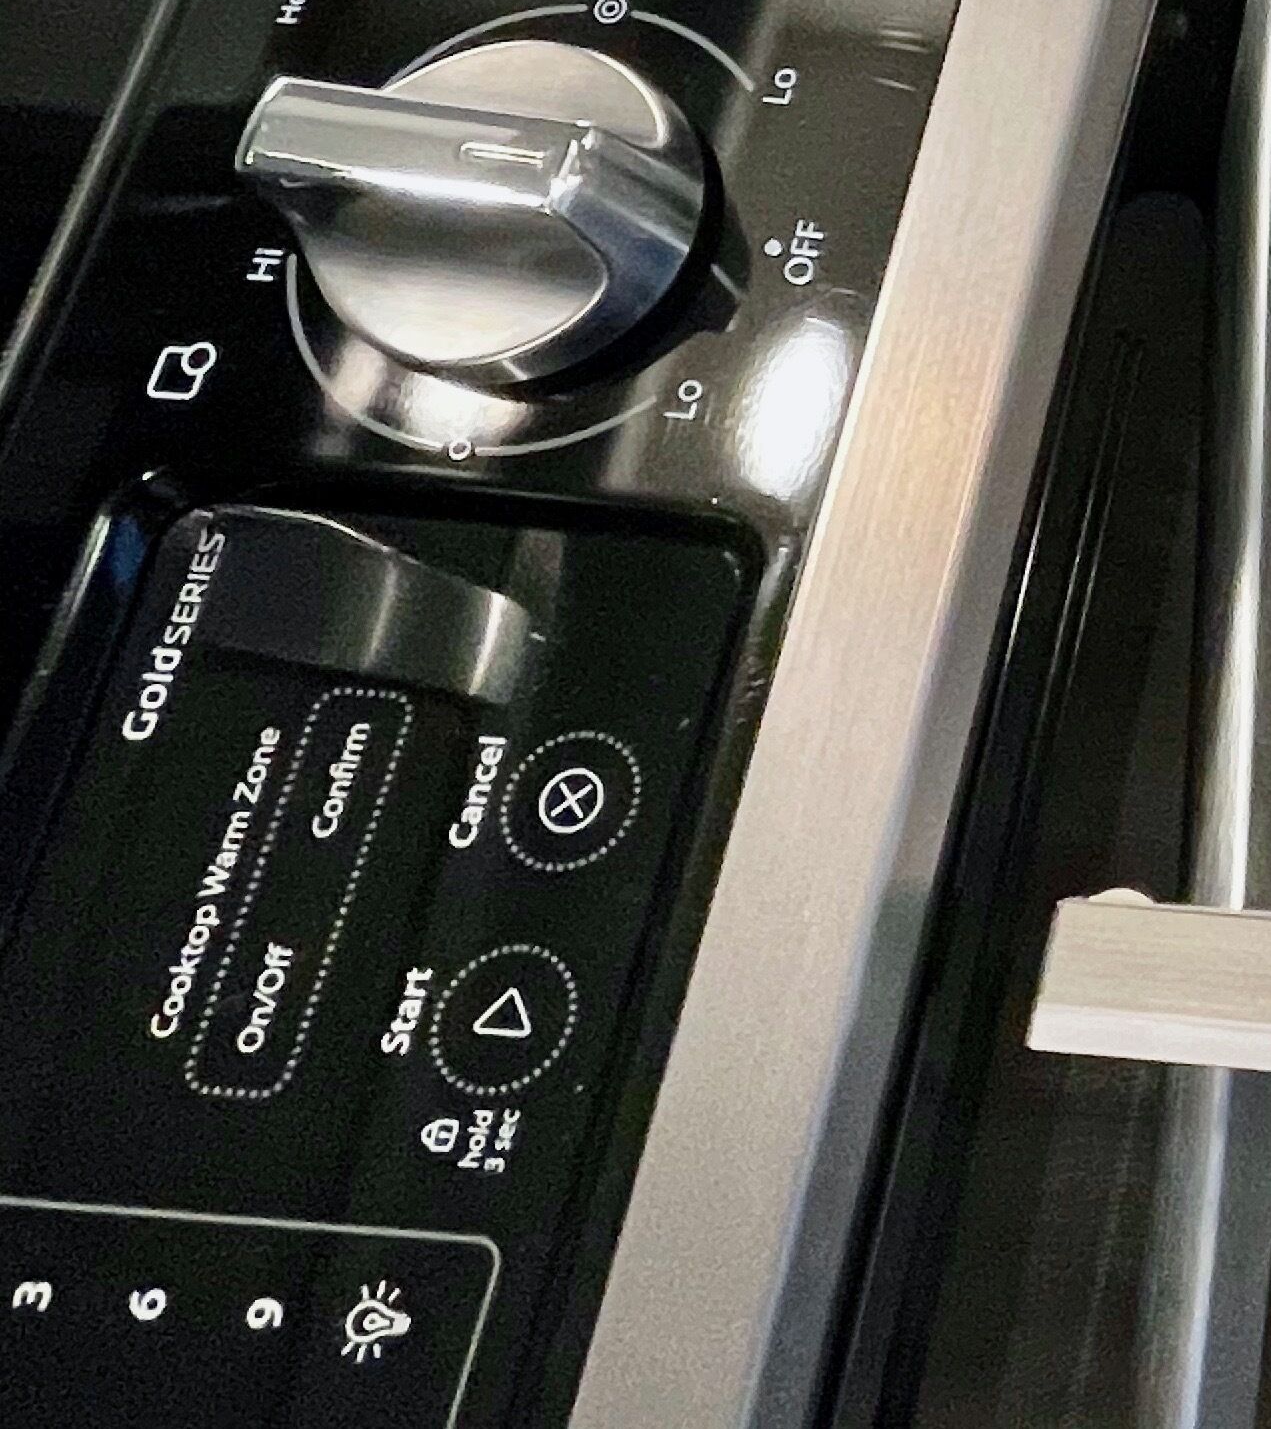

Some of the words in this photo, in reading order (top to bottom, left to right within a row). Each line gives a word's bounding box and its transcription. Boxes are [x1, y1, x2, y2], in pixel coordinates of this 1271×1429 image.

[762, 67, 797, 105] Lo
[246, 247, 285, 282] Hi
[783, 220, 826, 286] OFF
[663, 379, 704, 421] Lo
[312, 722, 371, 839] Confirm
[448, 735, 508, 849] Cancel
[150, 904, 221, 1038] Cooktop
[196, 811, 251, 898] Warm
[232, 726, 281, 804] Zone
[236, 941, 294, 1054] On/Off
[380, 967, 434, 1057] Start
[456, 1109, 495, 1169] hold
[494, 1107, 521, 1151] sec
[483, 1157, 506, 1173] 3
[12, 1281, 52, 1312] 3
[128, 1287, 167, 1321] 6
[246, 1297, 284, 1330] 9
